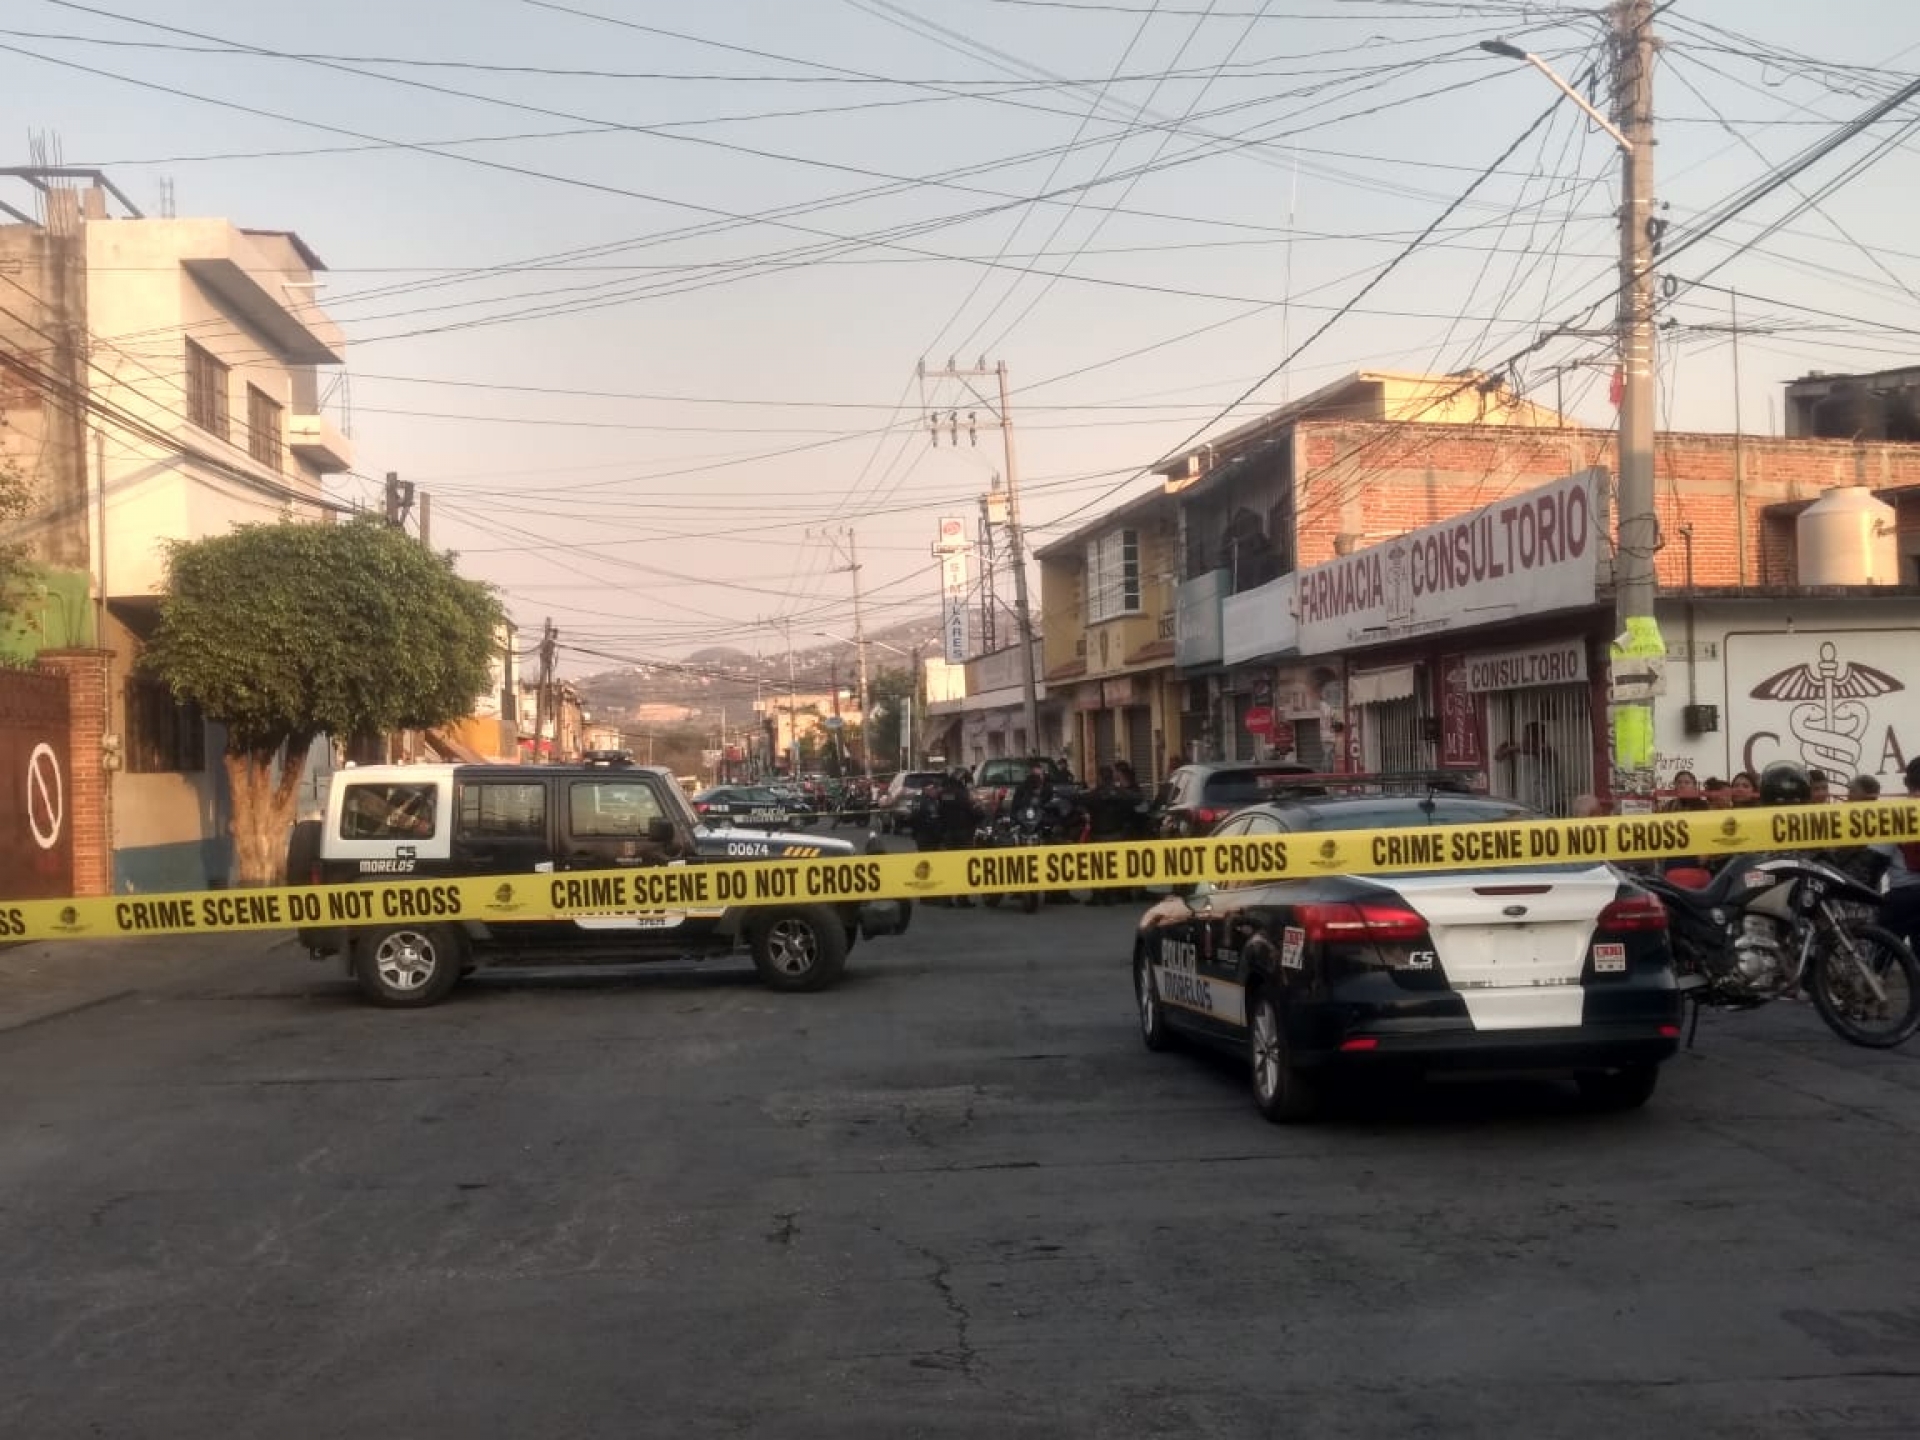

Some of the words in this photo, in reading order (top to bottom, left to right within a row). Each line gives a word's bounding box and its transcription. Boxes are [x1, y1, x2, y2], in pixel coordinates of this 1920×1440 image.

[1300, 553, 1384, 626] FARMACIA
[1411, 484, 1588, 597] CONSULTORIO
[1471, 649, 1579, 690] CONSULTORIO
[1373, 834, 1443, 865] CRIME
[1452, 830, 1522, 861] SCENE
[1530, 829, 1559, 857] DO
[1568, 827, 1605, 855] NOT
[1617, 822, 1689, 852] CROSS
[1773, 811, 1841, 843] CRIME
[1849, 807, 1918, 838] SCENE
[359, 860, 415, 873] MORELOS
[728, 842, 769, 856] 00674
[967, 854, 1038, 887] CRIME
[1046, 851, 1117, 882] SCENE
[1127, 848, 1155, 878] DO
[1165, 846, 1205, 875] NOT
[1215, 842, 1287, 873] CROSS
[551, 877, 626, 909] CRIME
[634, 872, 707, 904] SCENE
[717, 869, 747, 900] DO
[756, 867, 798, 897] NOT
[807, 862, 880, 895] CROSS
[117, 899, 195, 930] CRIME
[203, 895, 280, 925] SCENE
[289, 892, 320, 921] DO
[329, 890, 373, 919] NOT
[383, 885, 460, 917] CROSS
[1410, 951, 1435, 967] CS
